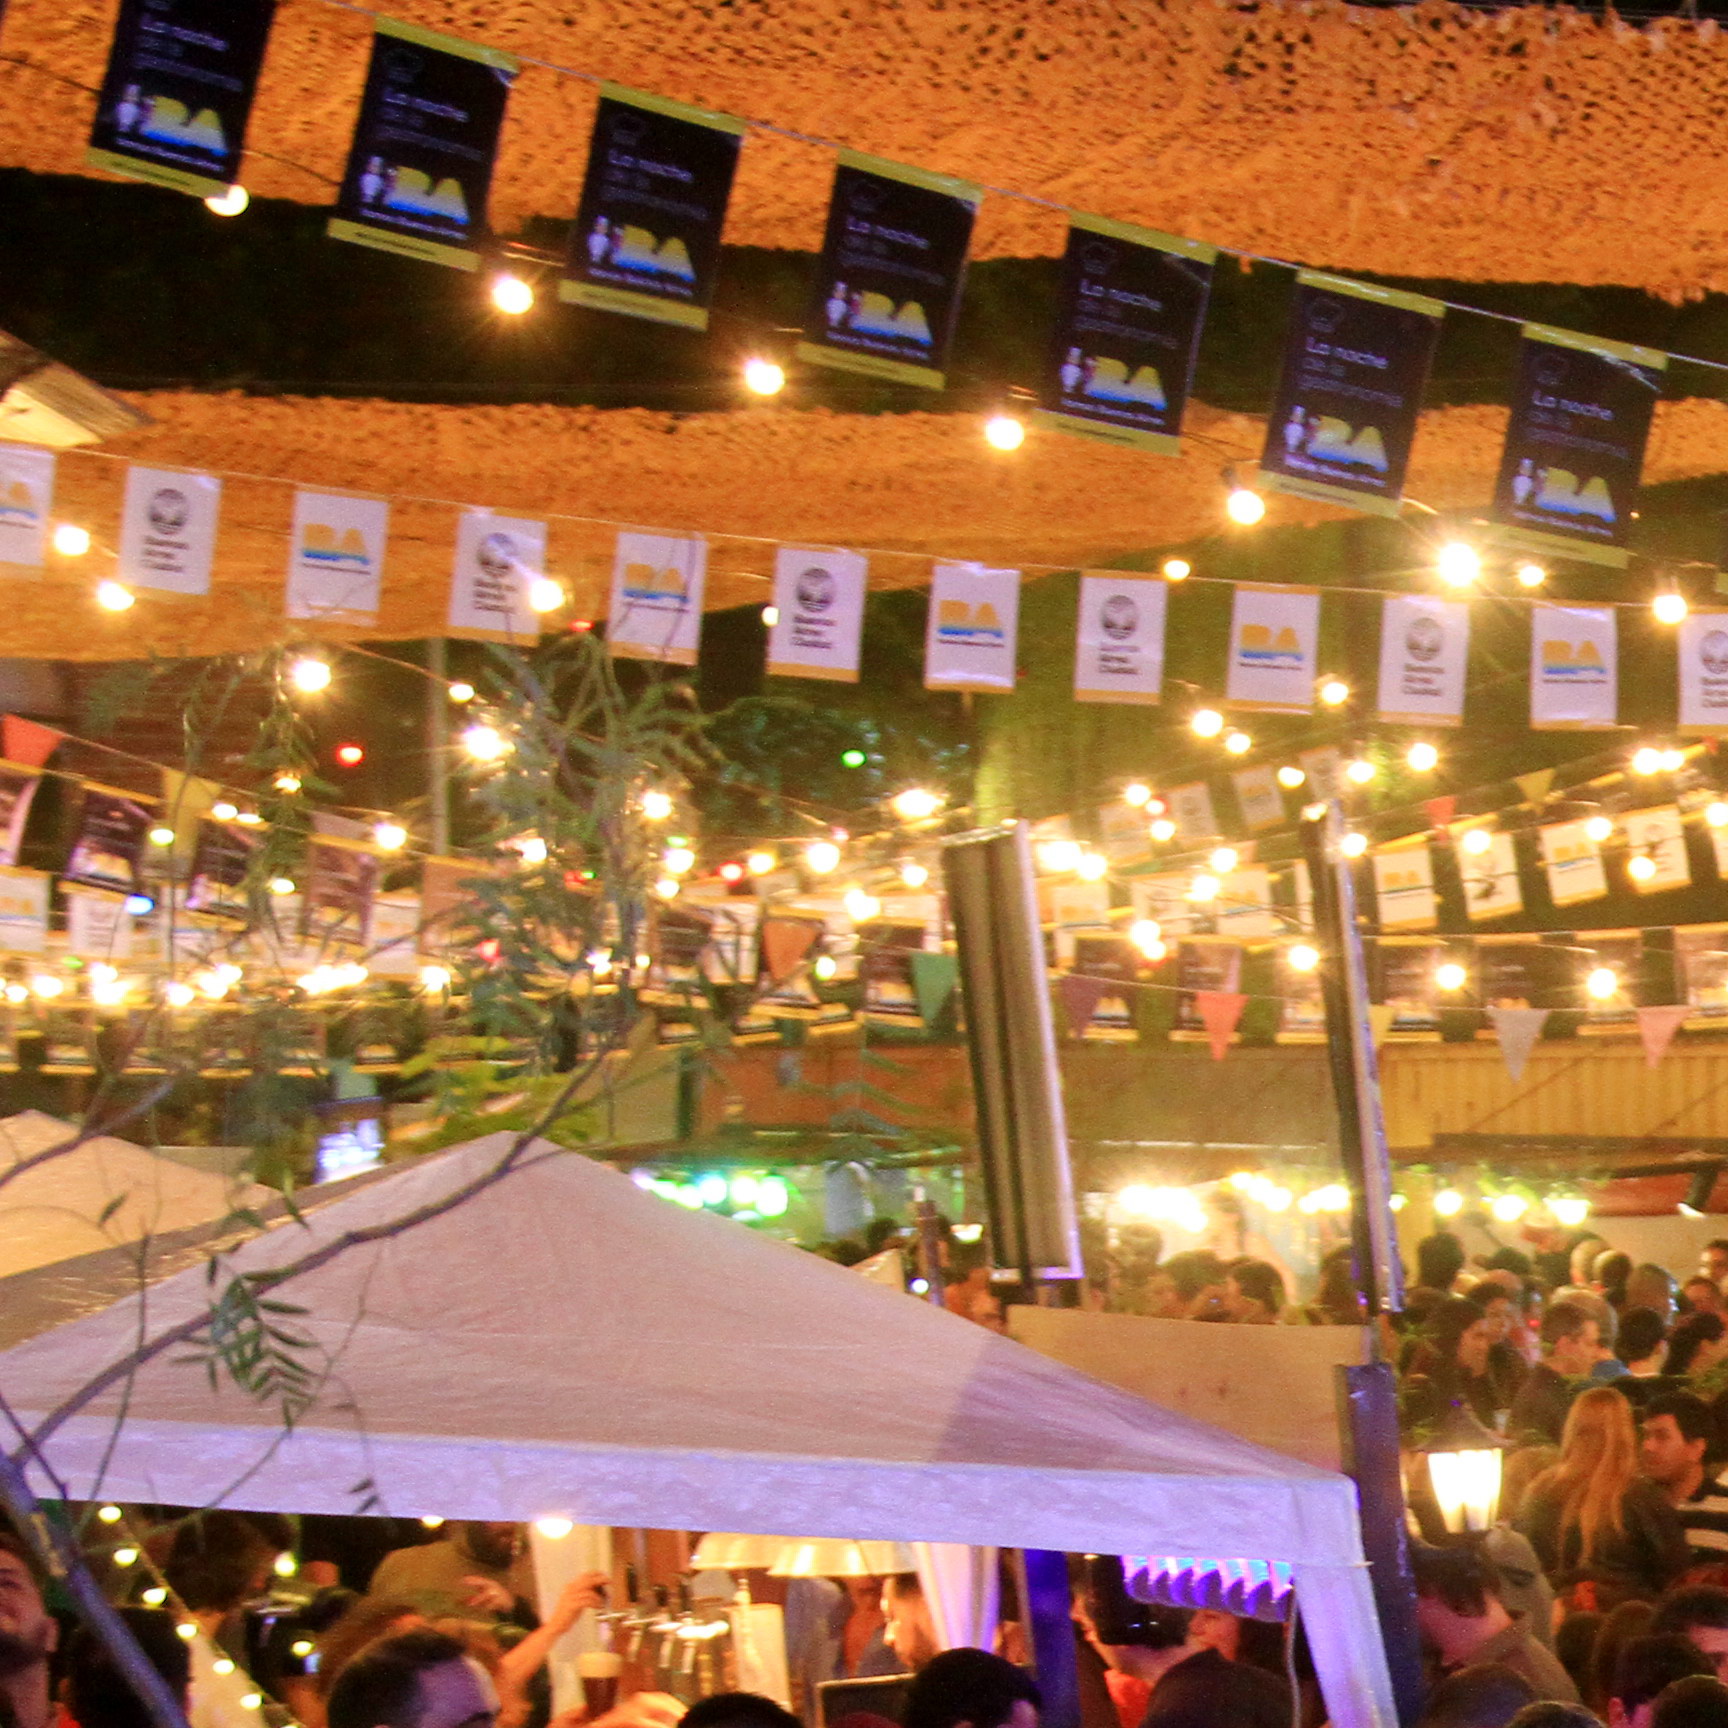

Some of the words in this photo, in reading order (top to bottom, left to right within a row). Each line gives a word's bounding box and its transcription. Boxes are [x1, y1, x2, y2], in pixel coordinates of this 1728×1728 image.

[302, 523, 370, 566] BA
[938, 599, 1004, 638] BA
[1239, 624, 1303, 661] BA
[1542, 640, 1607, 675] BA
